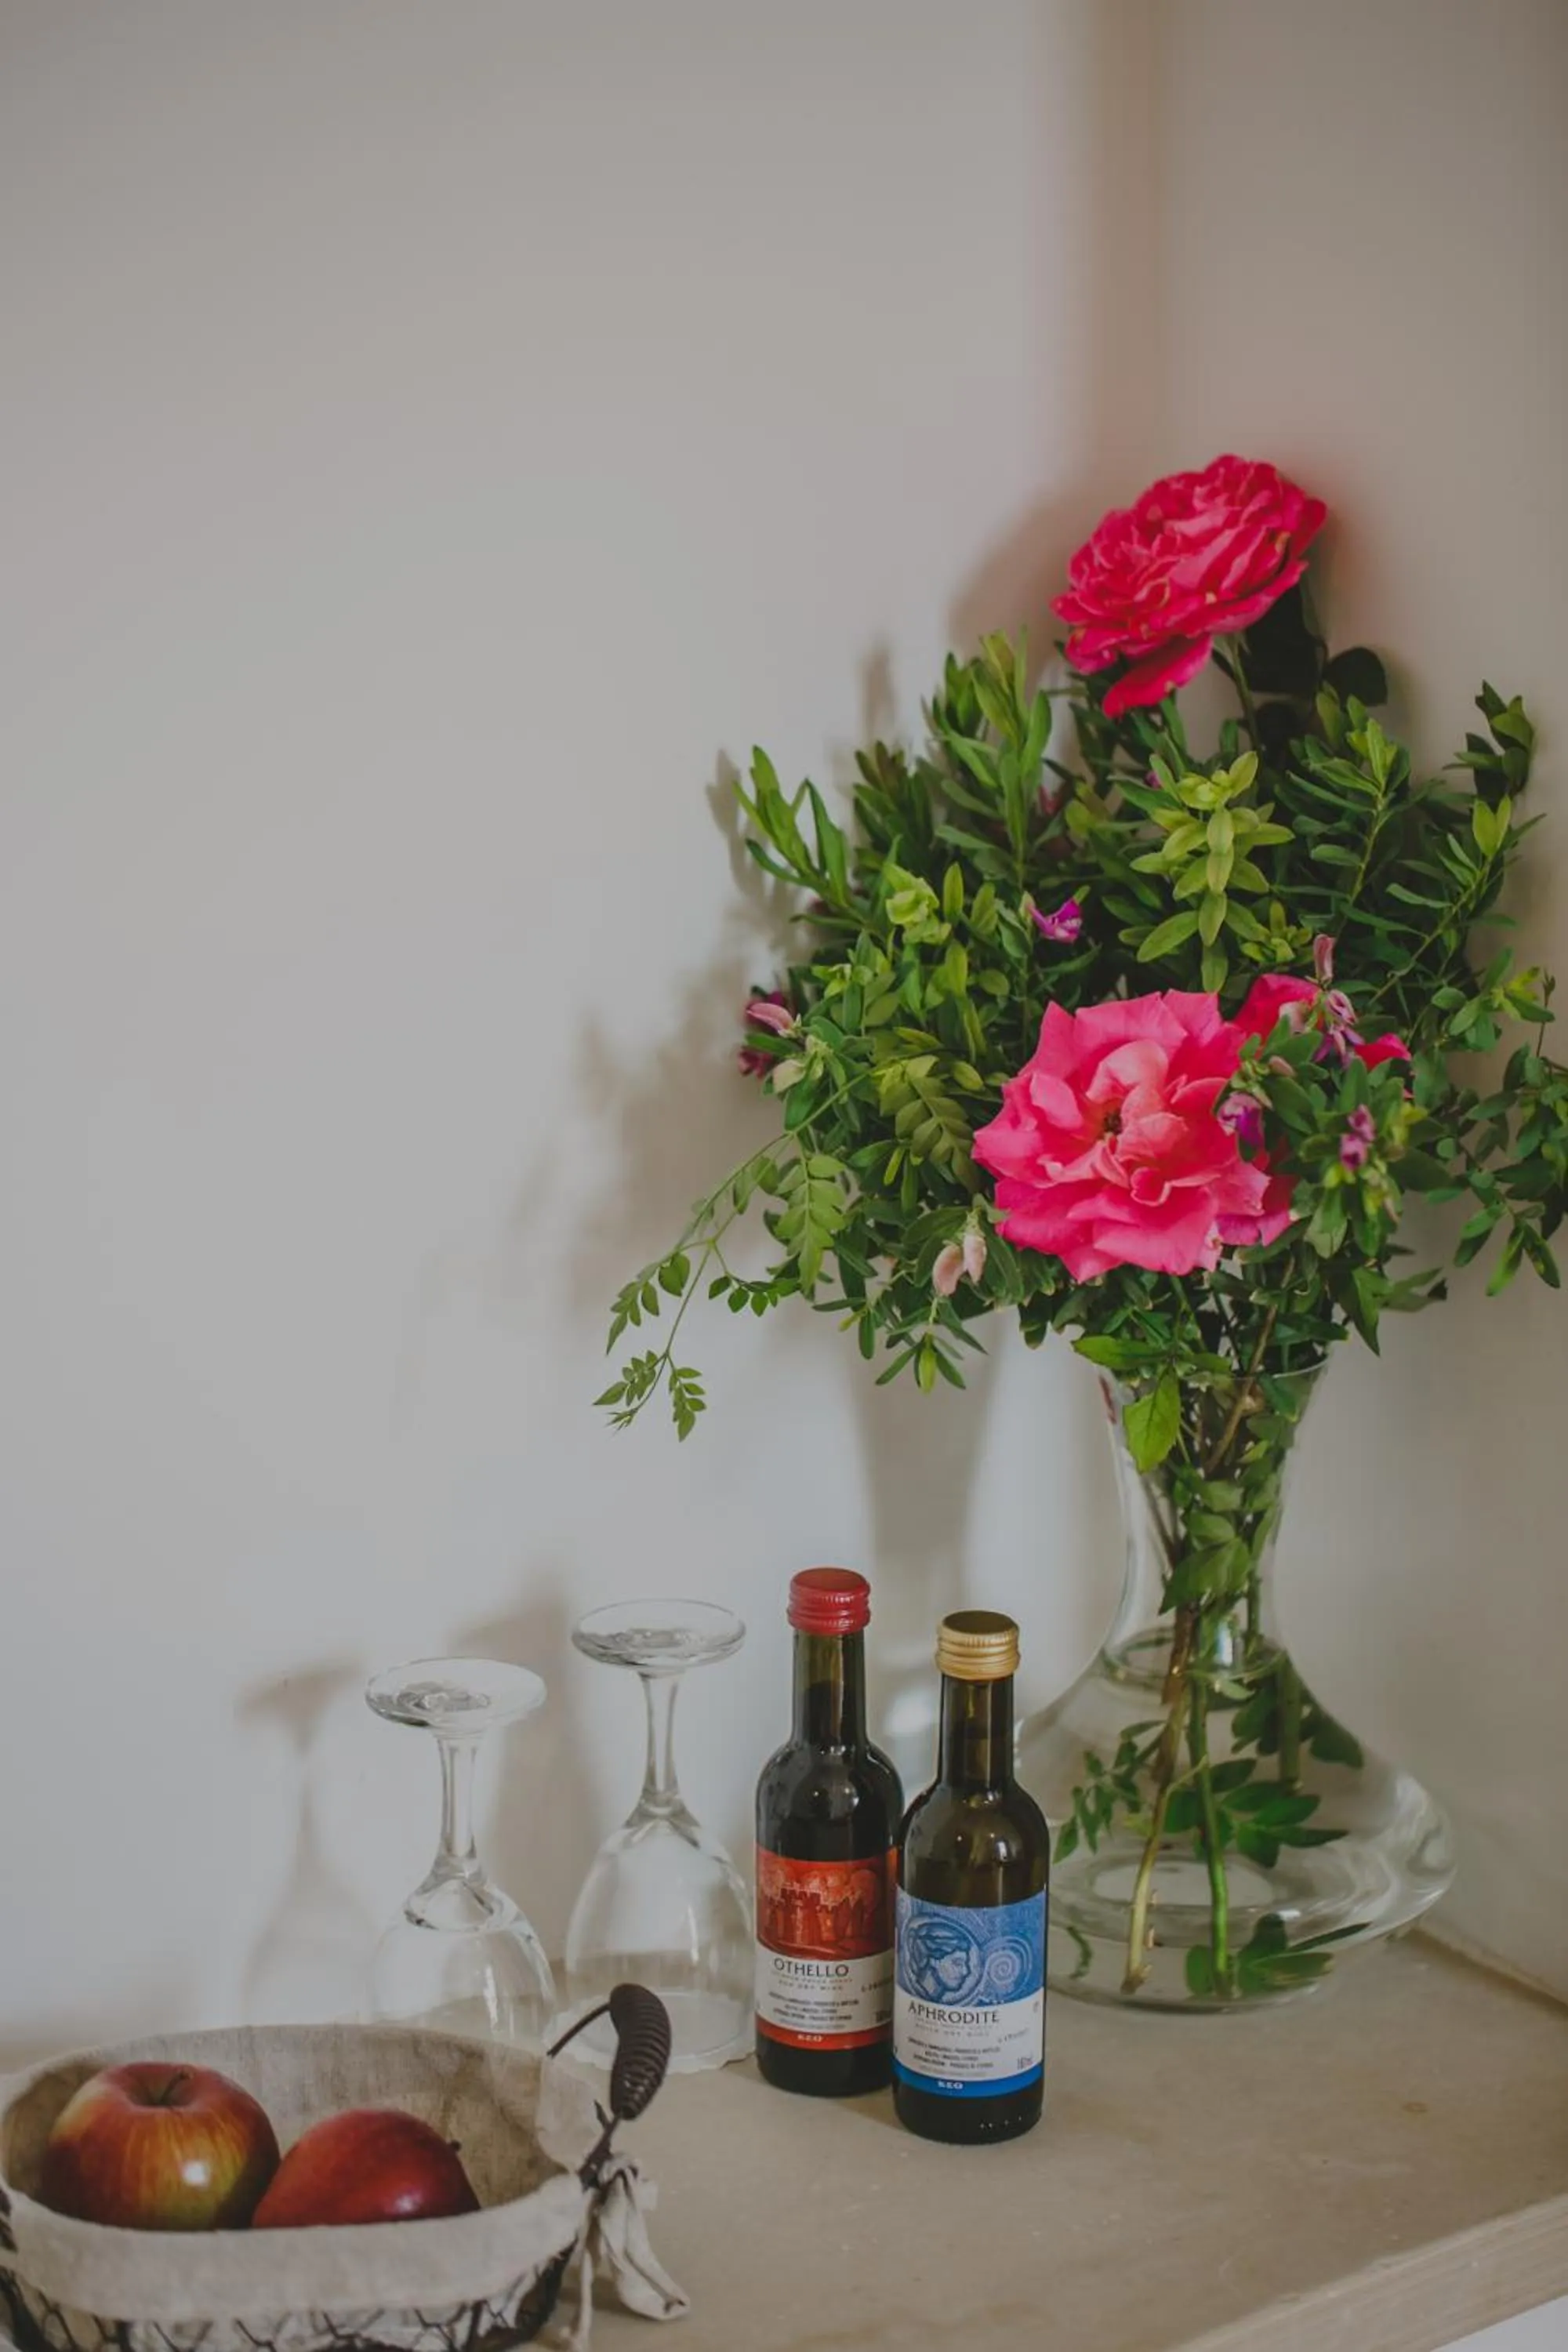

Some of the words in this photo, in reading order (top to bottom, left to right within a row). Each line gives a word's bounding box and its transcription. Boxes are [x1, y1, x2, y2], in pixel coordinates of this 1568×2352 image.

[774, 1958, 849, 1977] OTHELLO
[908, 2000, 1000, 2024] APHRODITE
[797, 2033, 823, 2042] KEO
[938, 2081, 964, 2089] KEO
